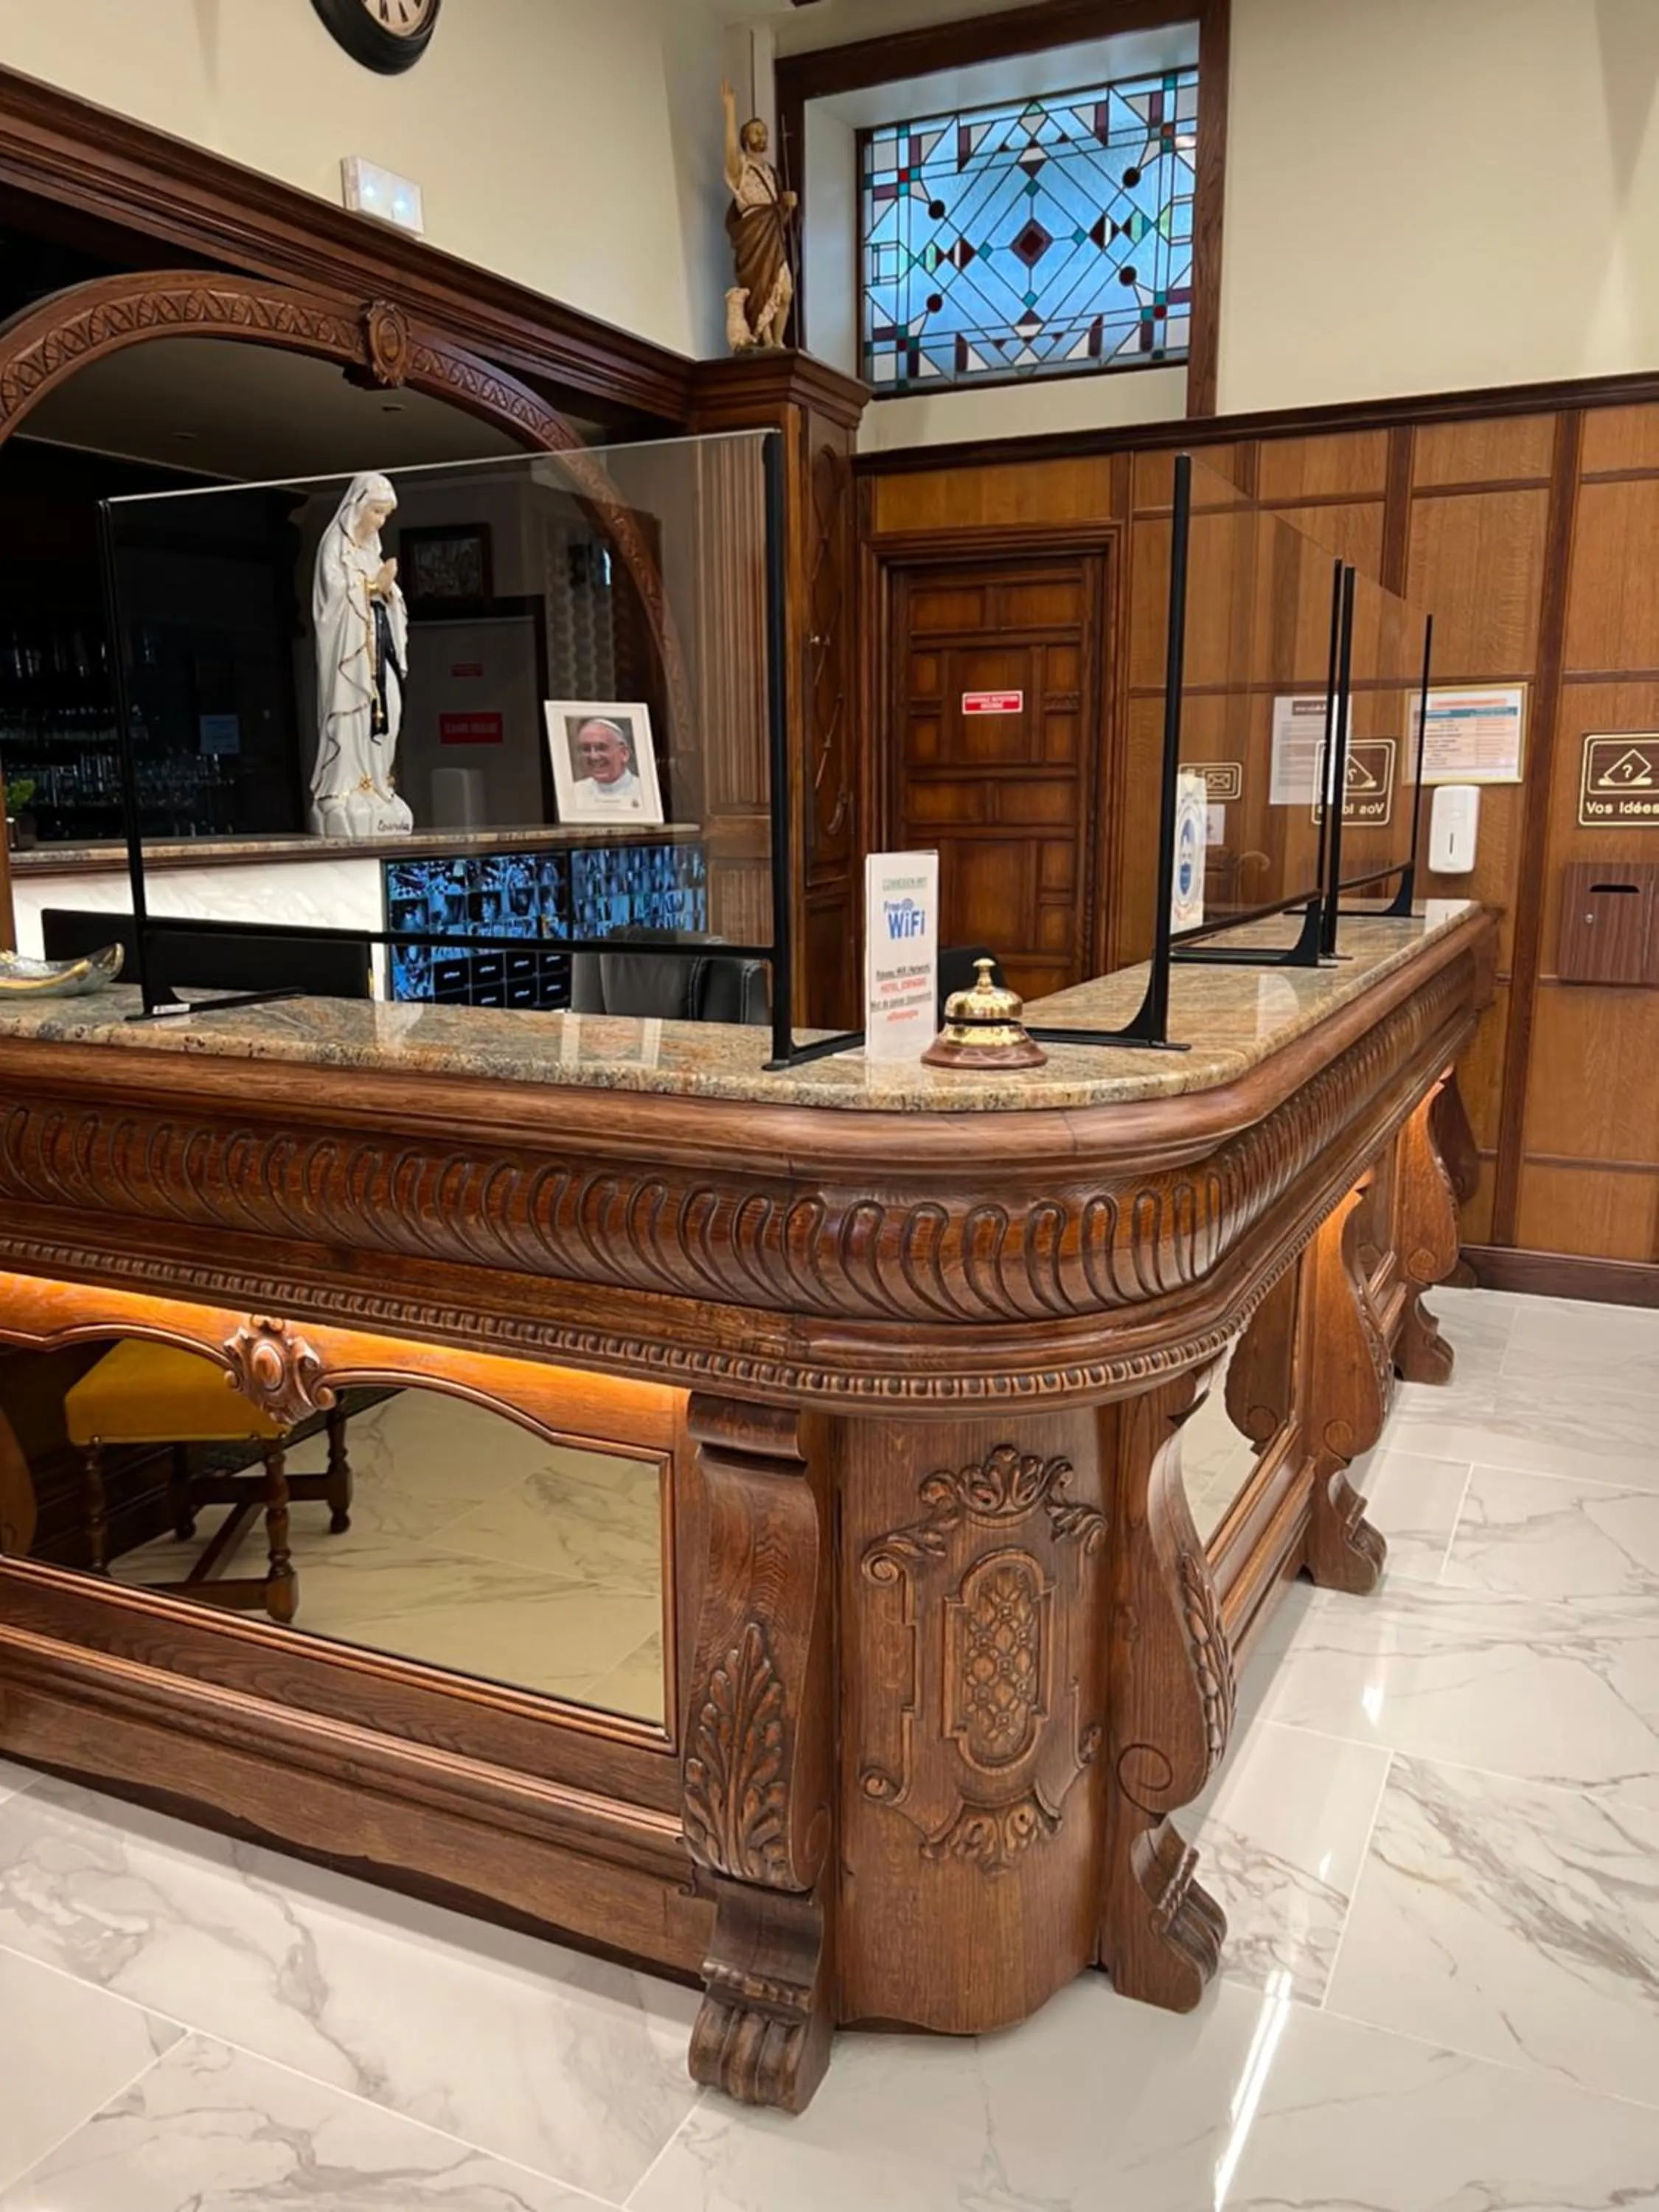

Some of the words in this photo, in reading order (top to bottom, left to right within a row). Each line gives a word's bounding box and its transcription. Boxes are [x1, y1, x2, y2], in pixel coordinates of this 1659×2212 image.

[1586, 801, 1613, 814] Vos
[1619, 801, 1659, 814] Idées
[888, 909, 925, 939] WiFi
